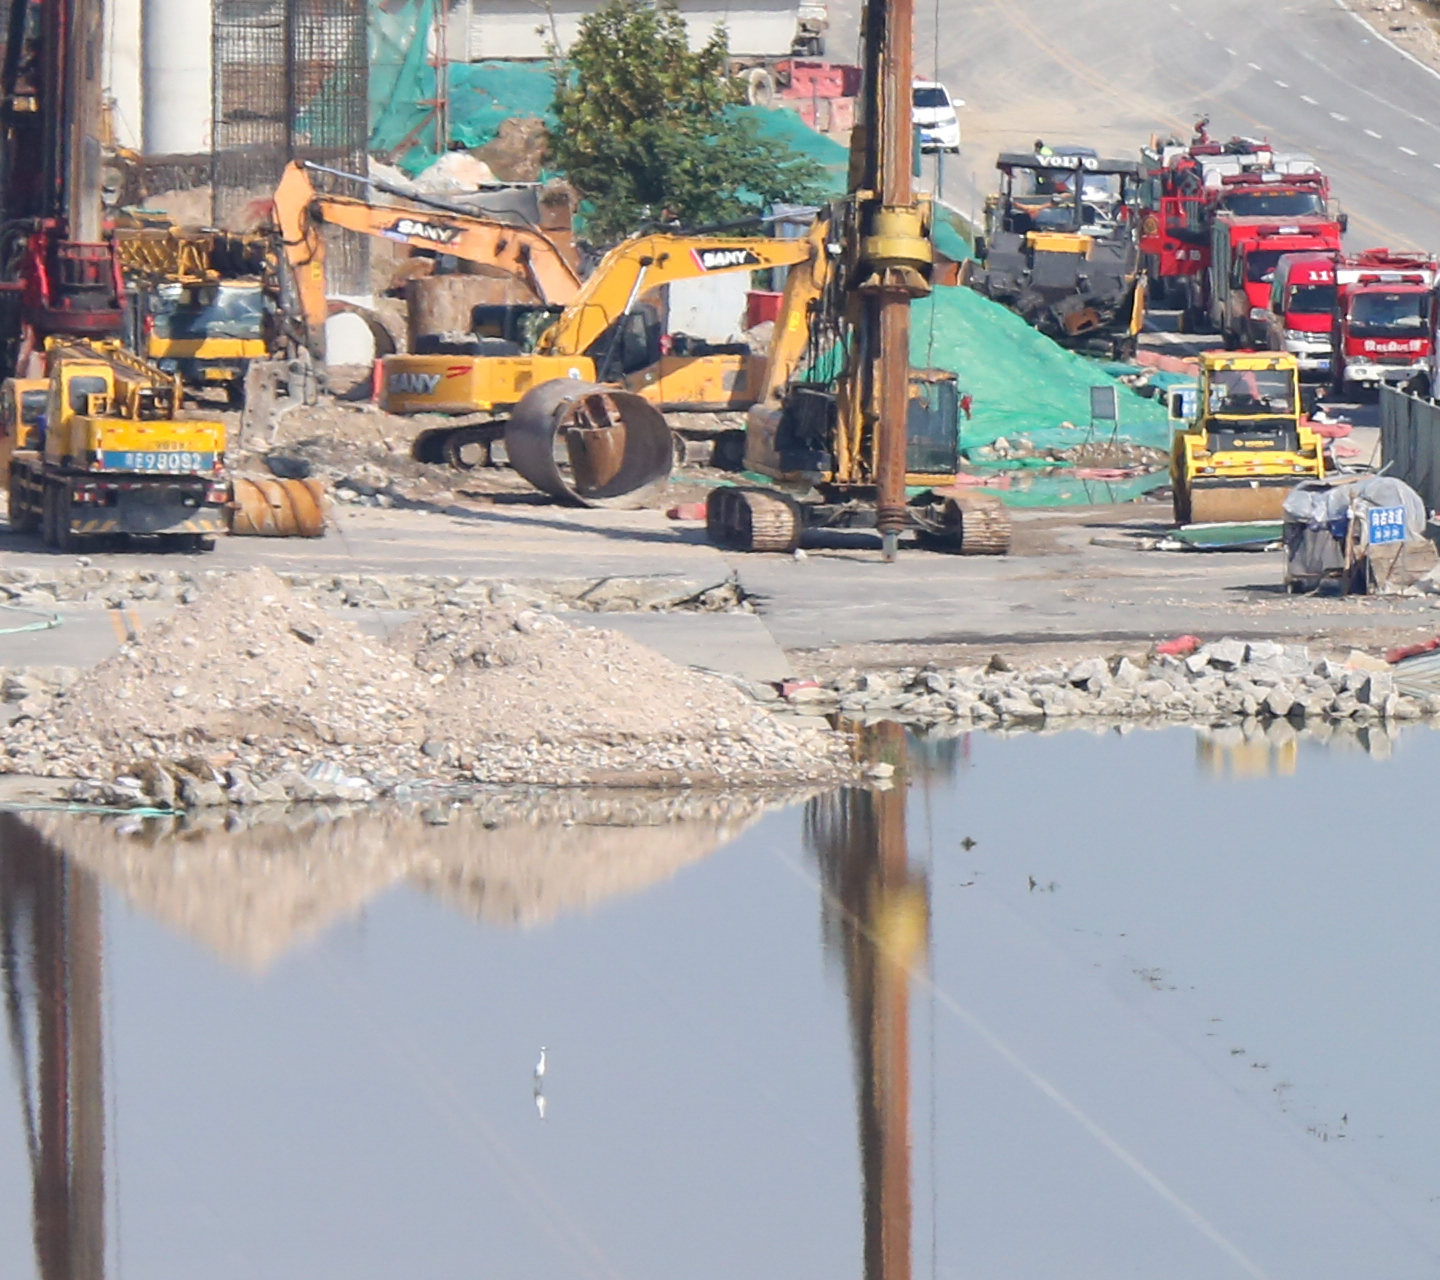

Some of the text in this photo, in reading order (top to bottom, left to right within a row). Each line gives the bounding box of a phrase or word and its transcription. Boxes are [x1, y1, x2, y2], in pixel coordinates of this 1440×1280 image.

[1037, 154, 1098, 169] VOLVO
[397, 219, 453, 242] SANY
[703, 250, 747, 267] SANY
[1308, 270, 1335, 281] 11
